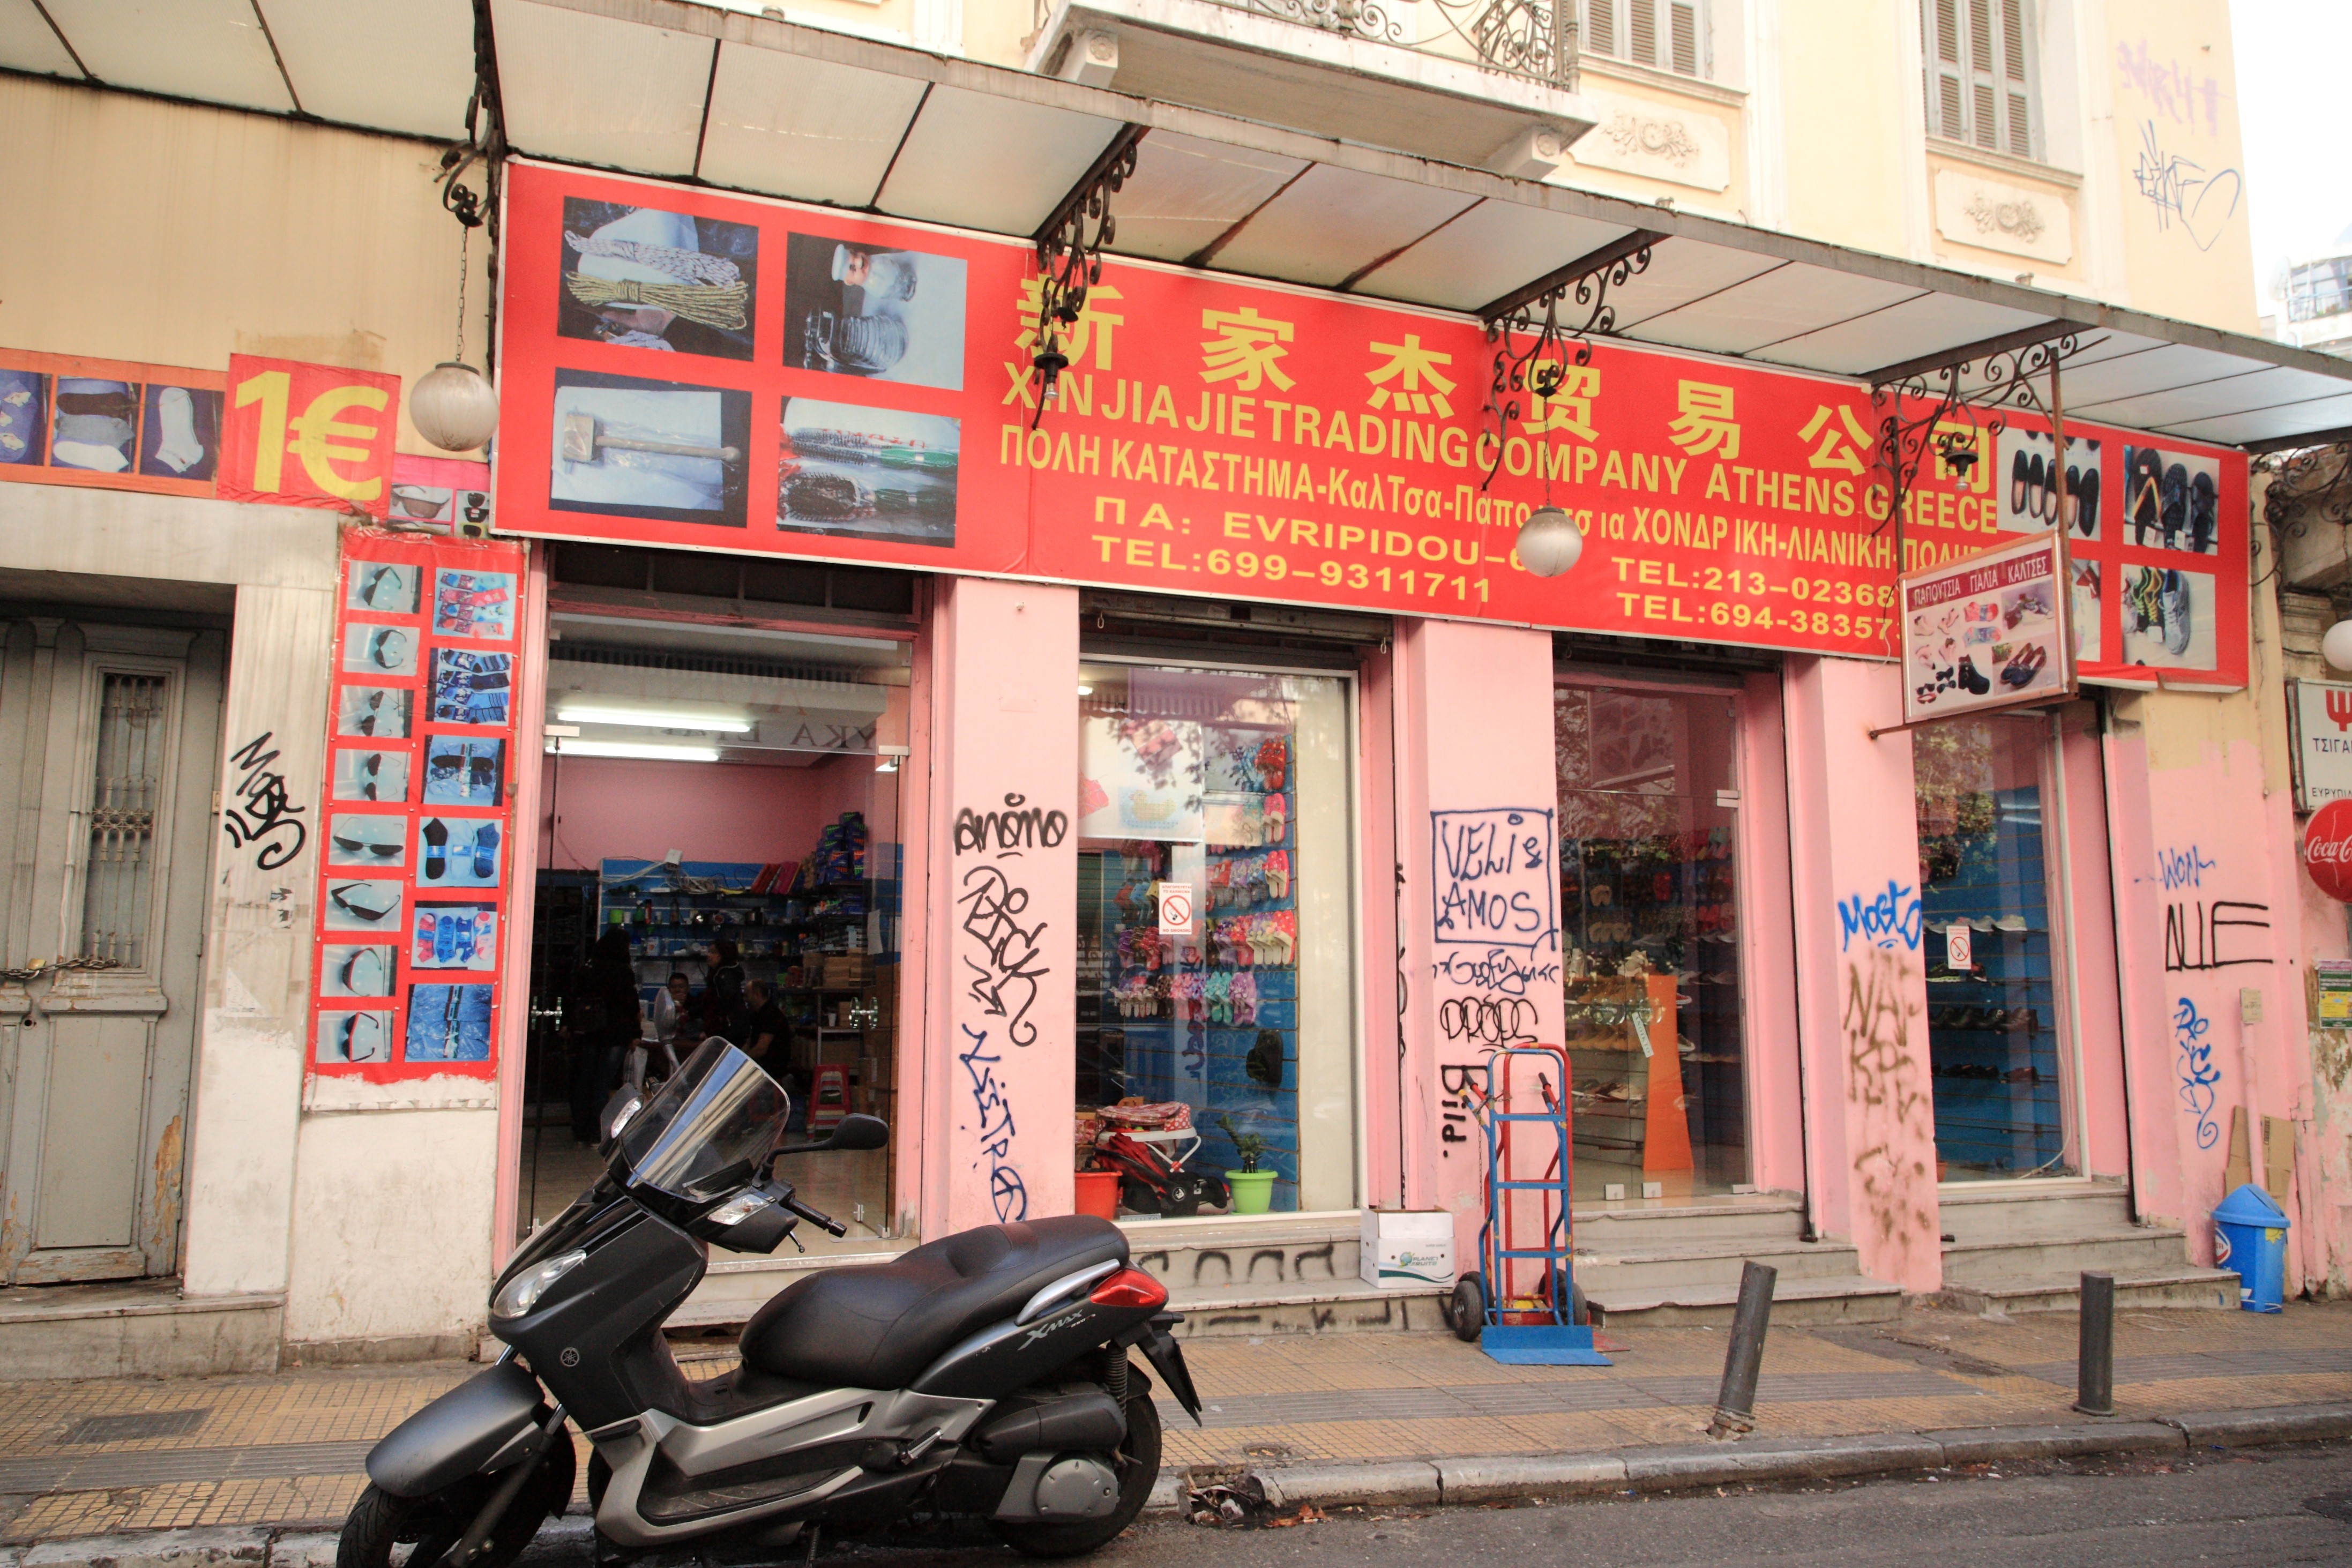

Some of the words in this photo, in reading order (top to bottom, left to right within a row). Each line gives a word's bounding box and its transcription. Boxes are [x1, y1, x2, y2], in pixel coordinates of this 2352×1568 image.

[235, 370, 389, 501] 1€
[1000, 424, 1100, 475] ΠΟΛΗ
[1101, 378, 1179, 428] JIA
[1186, 392, 1255, 438] JIE
[1264, 399, 1468, 468] TRADING
[1475, 433, 1687, 495] COMPANY
[1705, 463, 1855, 517] ATHENS
[1864, 484, 1997, 534] GREECE
[1092, 534, 1489, 602] TEL:699-9311711
[1914, 578, 1961, 606] ΠΑΠΟΥΤΣΙΑ
[2007, 556, 2048, 584] ΚΑΛΤΣΕΣ
[1616, 592, 1900, 641] TEL:694-38357
[2312, 737, 2352, 753] ΤΣΙΓΑ
